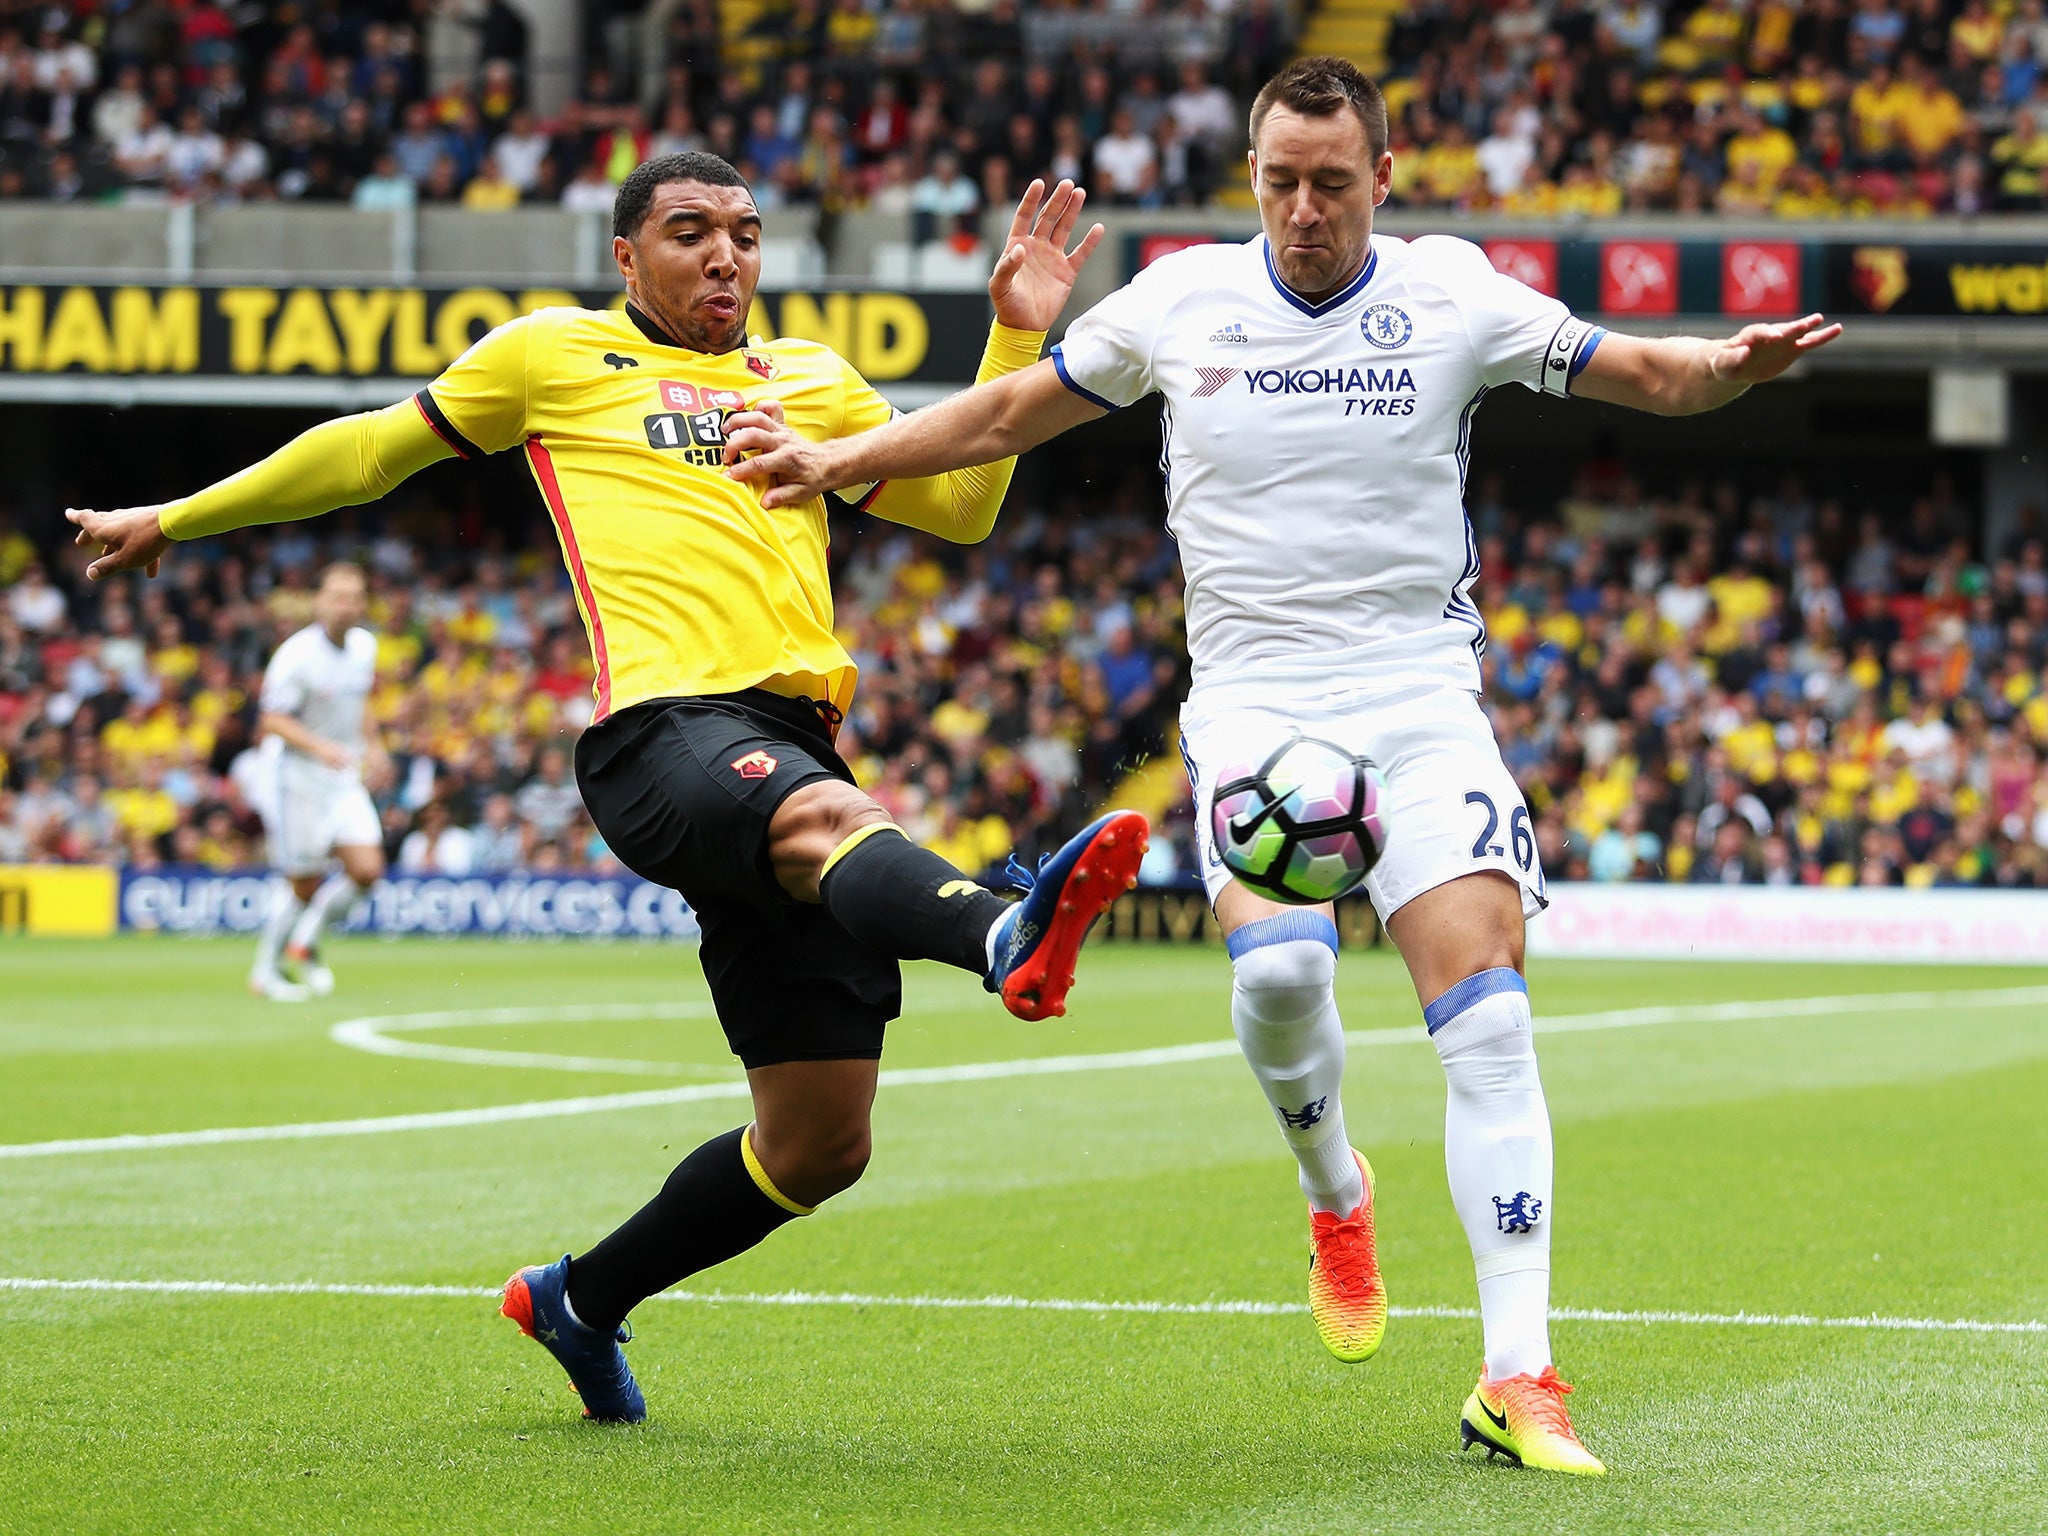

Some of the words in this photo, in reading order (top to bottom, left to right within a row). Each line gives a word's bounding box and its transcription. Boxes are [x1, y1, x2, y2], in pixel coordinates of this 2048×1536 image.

[1367, 305, 1402, 316] CHELSEA
[217, 287, 582, 377] TAYLO
[1209, 333, 1248, 343] adidas
[1244, 368, 1417, 394] YOKOHAMA
[1344, 398, 1415, 416] TYRES
[651, 411, 742, 445] 13
[1464, 791, 1533, 873] 26
